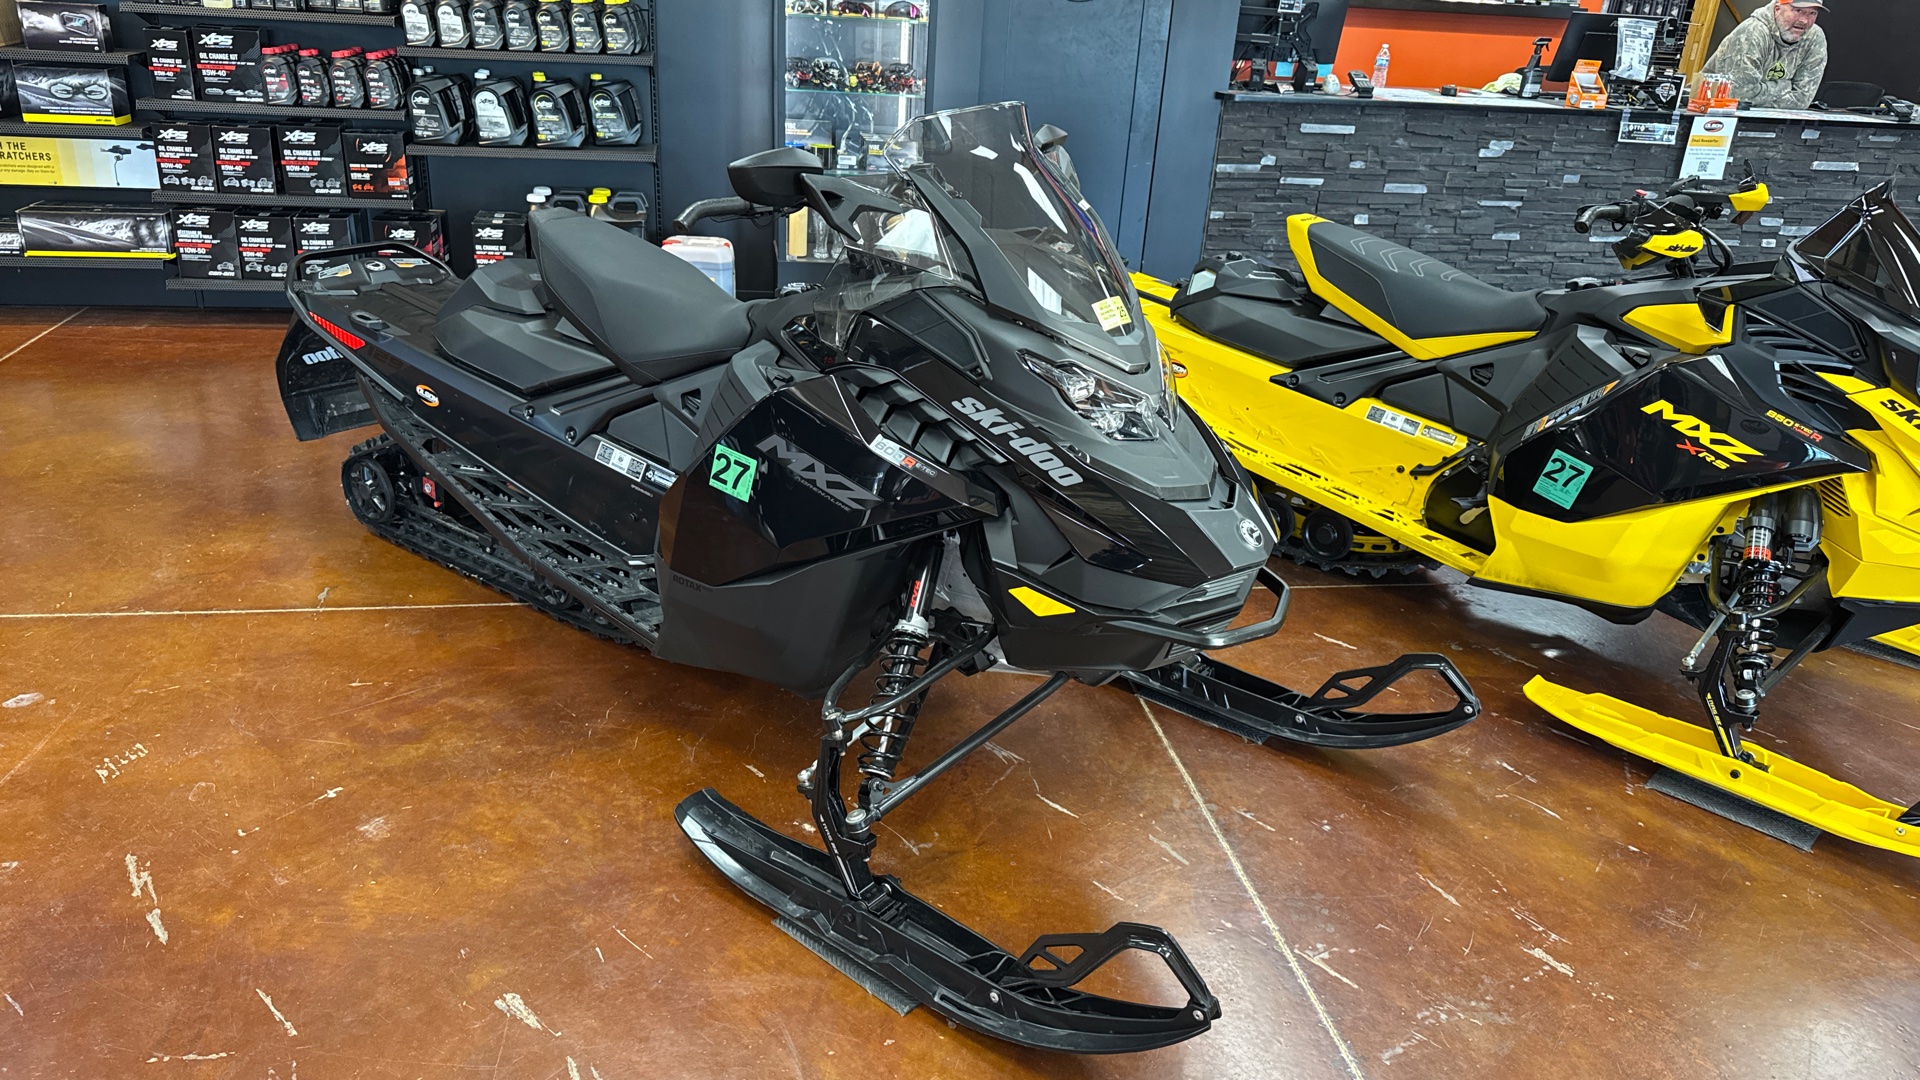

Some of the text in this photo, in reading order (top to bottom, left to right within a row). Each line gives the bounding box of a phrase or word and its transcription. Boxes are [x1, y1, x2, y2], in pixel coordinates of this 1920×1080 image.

[150, 38, 178, 48] XPS
[198, 32, 234, 46] XPS
[157, 128, 189, 140] XPS
[218, 131, 249, 142] XPS
[282, 130, 317, 141] XPS
[6, 142, 26, 150] THE
[360, 142, 388, 152] XPS
[176, 213, 210, 225] XPS
[240, 219, 269, 230] XPS
[300, 222, 330, 232] XPS
[475, 227, 504, 238] XPS
[389, 229, 416, 238] XPS
[415, 388, 439, 404] OLSON
[1766, 410, 1794, 427] 850
[1640, 400, 1764, 463] MXZ
[711, 453, 750, 490] 27
[756, 433, 883, 510] MXZ
[1542, 457, 1586, 488] 27
[794, 476, 852, 512] ADRENALINE
[672, 575, 701, 592] ROTAX
